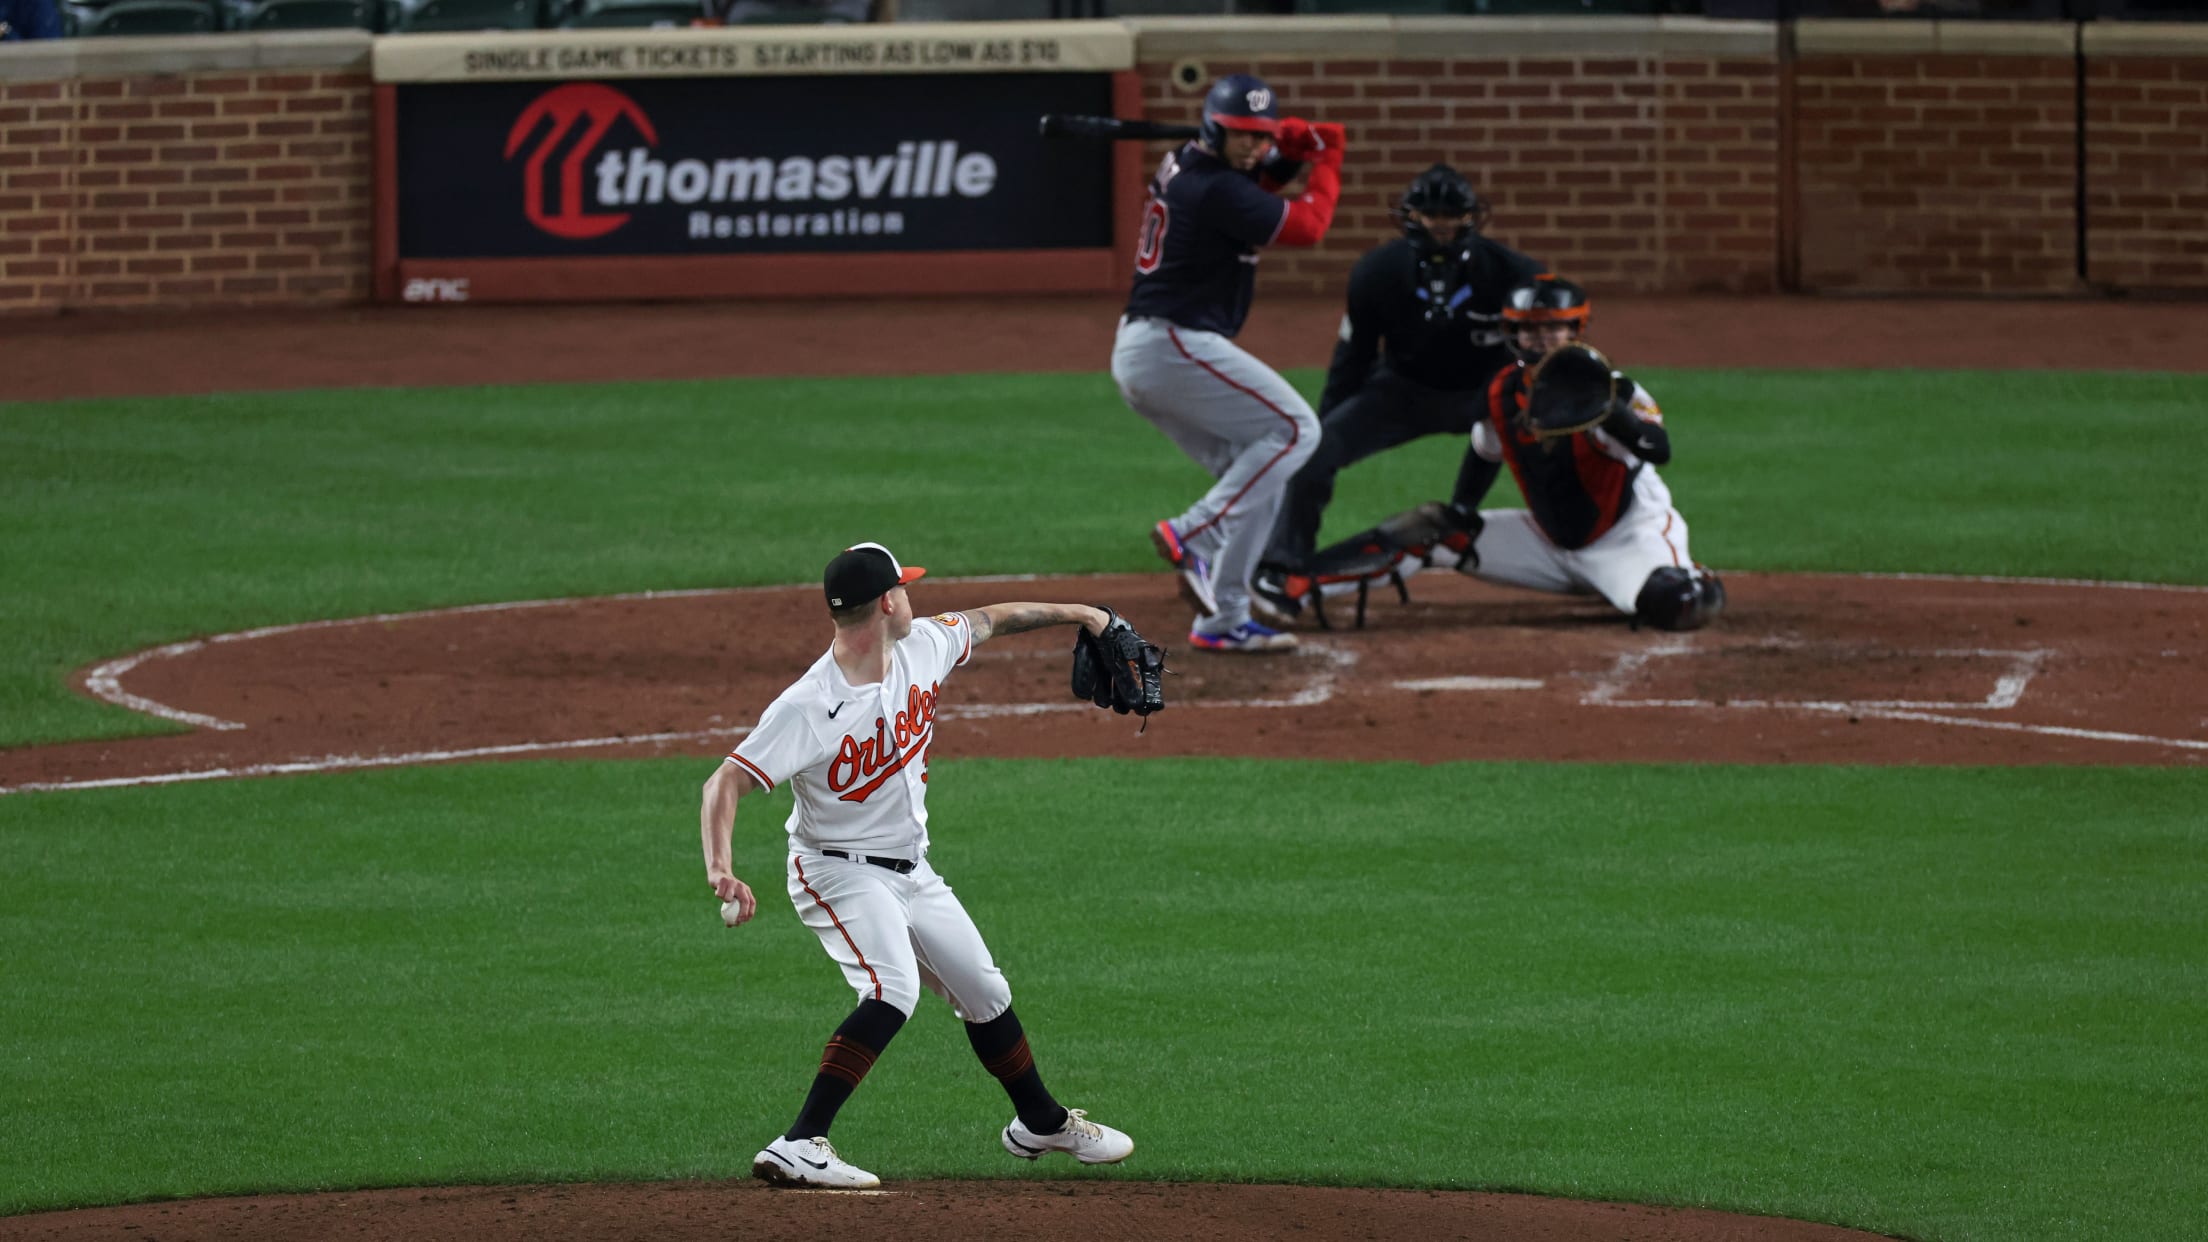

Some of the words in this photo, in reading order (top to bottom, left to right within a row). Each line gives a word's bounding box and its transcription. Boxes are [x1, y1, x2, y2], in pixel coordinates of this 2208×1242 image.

[465, 48, 549, 73] SINGLE
[557, 47, 626, 71] GAME
[635, 45, 738, 69] TICKETS
[754, 42, 876, 66] STARTING
[881, 40, 914, 64] AS
[919, 39, 977, 63] LOW
[980, 38, 1014, 63] AS
[1019, 37, 1060, 62] $10
[596, 140, 998, 205] thomasville
[688, 207, 905, 239] Restoration
